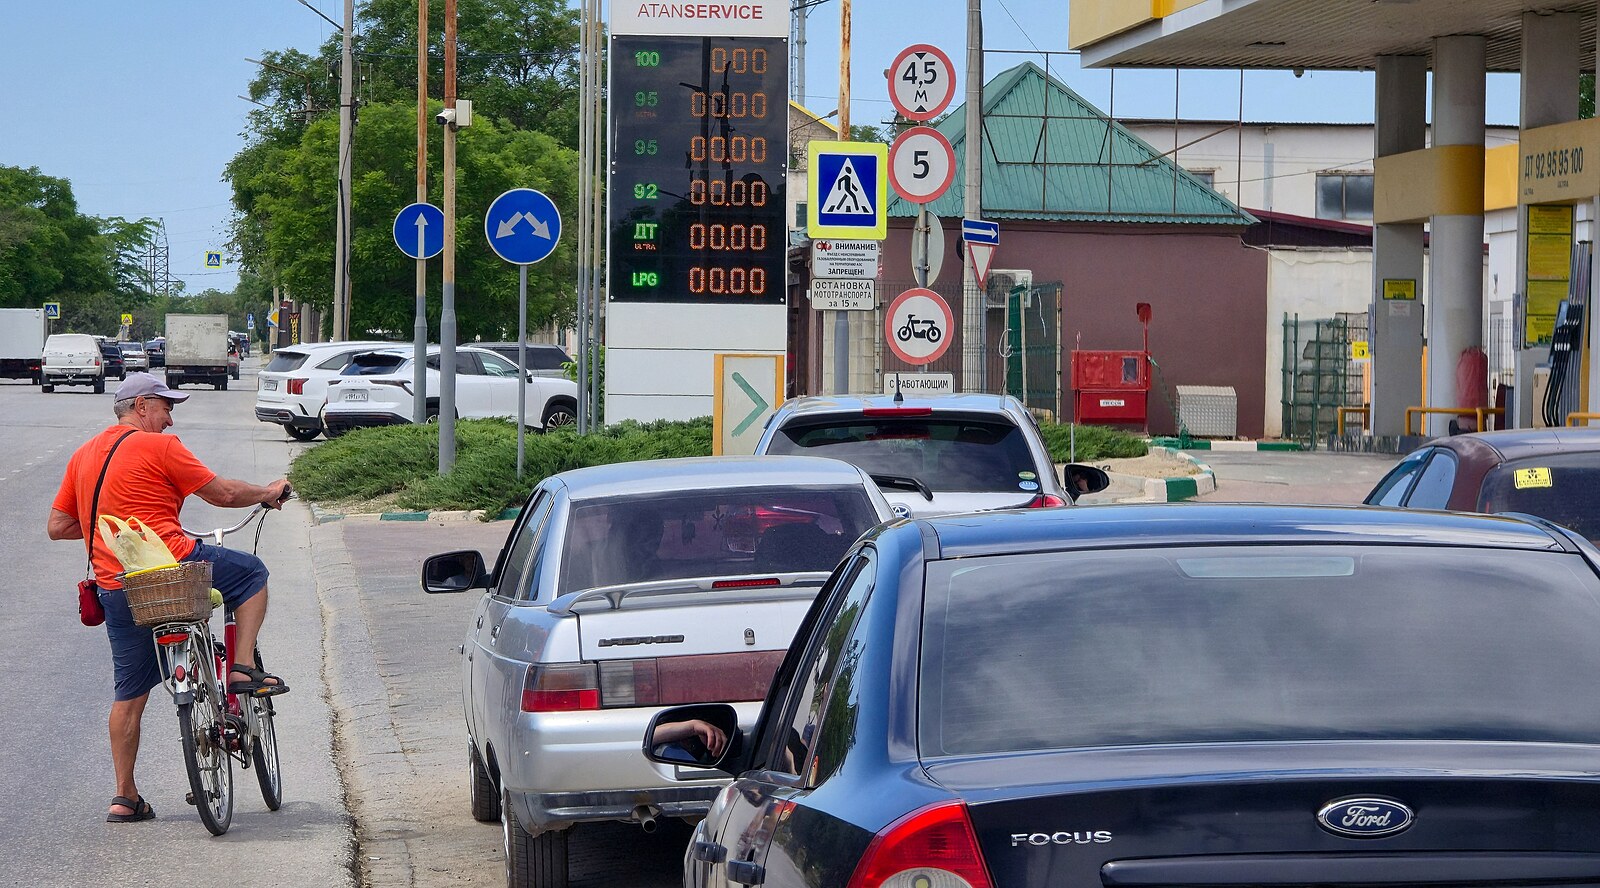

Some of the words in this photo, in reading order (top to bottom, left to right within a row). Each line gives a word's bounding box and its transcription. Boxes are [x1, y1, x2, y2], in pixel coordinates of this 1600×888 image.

[638, 3, 763, 19] ATANSERVICE
[635, 51, 660, 67] 100
[903, 61, 937, 88] 4,5
[635, 91, 658, 107] 95
[691, 91, 767, 119] 00.00
[635, 139, 658, 155] 95
[690, 136, 766, 162] 00.00
[913, 150, 930, 179] 5
[1525, 154, 1533, 180] ДТ
[1536, 153, 1545, 179] 92
[1547, 151, 1557, 177] 95
[1559, 148, 1569, 176] 95
[1571, 146, 1583, 174] 100
[634, 184, 658, 199] 92
[690, 179, 766, 206] 00.00
[633, 223, 658, 240] ДТ
[690, 223, 766, 250] 00.00
[632, 272, 657, 286] LPG
[689, 267, 765, 294] 00.00
[828, 268, 865, 276] ЗАПРЕЩЕН!
[814, 291, 872, 299] МОТОТРАНСПОРТА
[815, 281, 871, 290] ОСТАНОВКА
[889, 380, 894, 388] С
[1342, 805, 1391, 827] Ford
[1011, 831, 1113, 847] FOCUS
